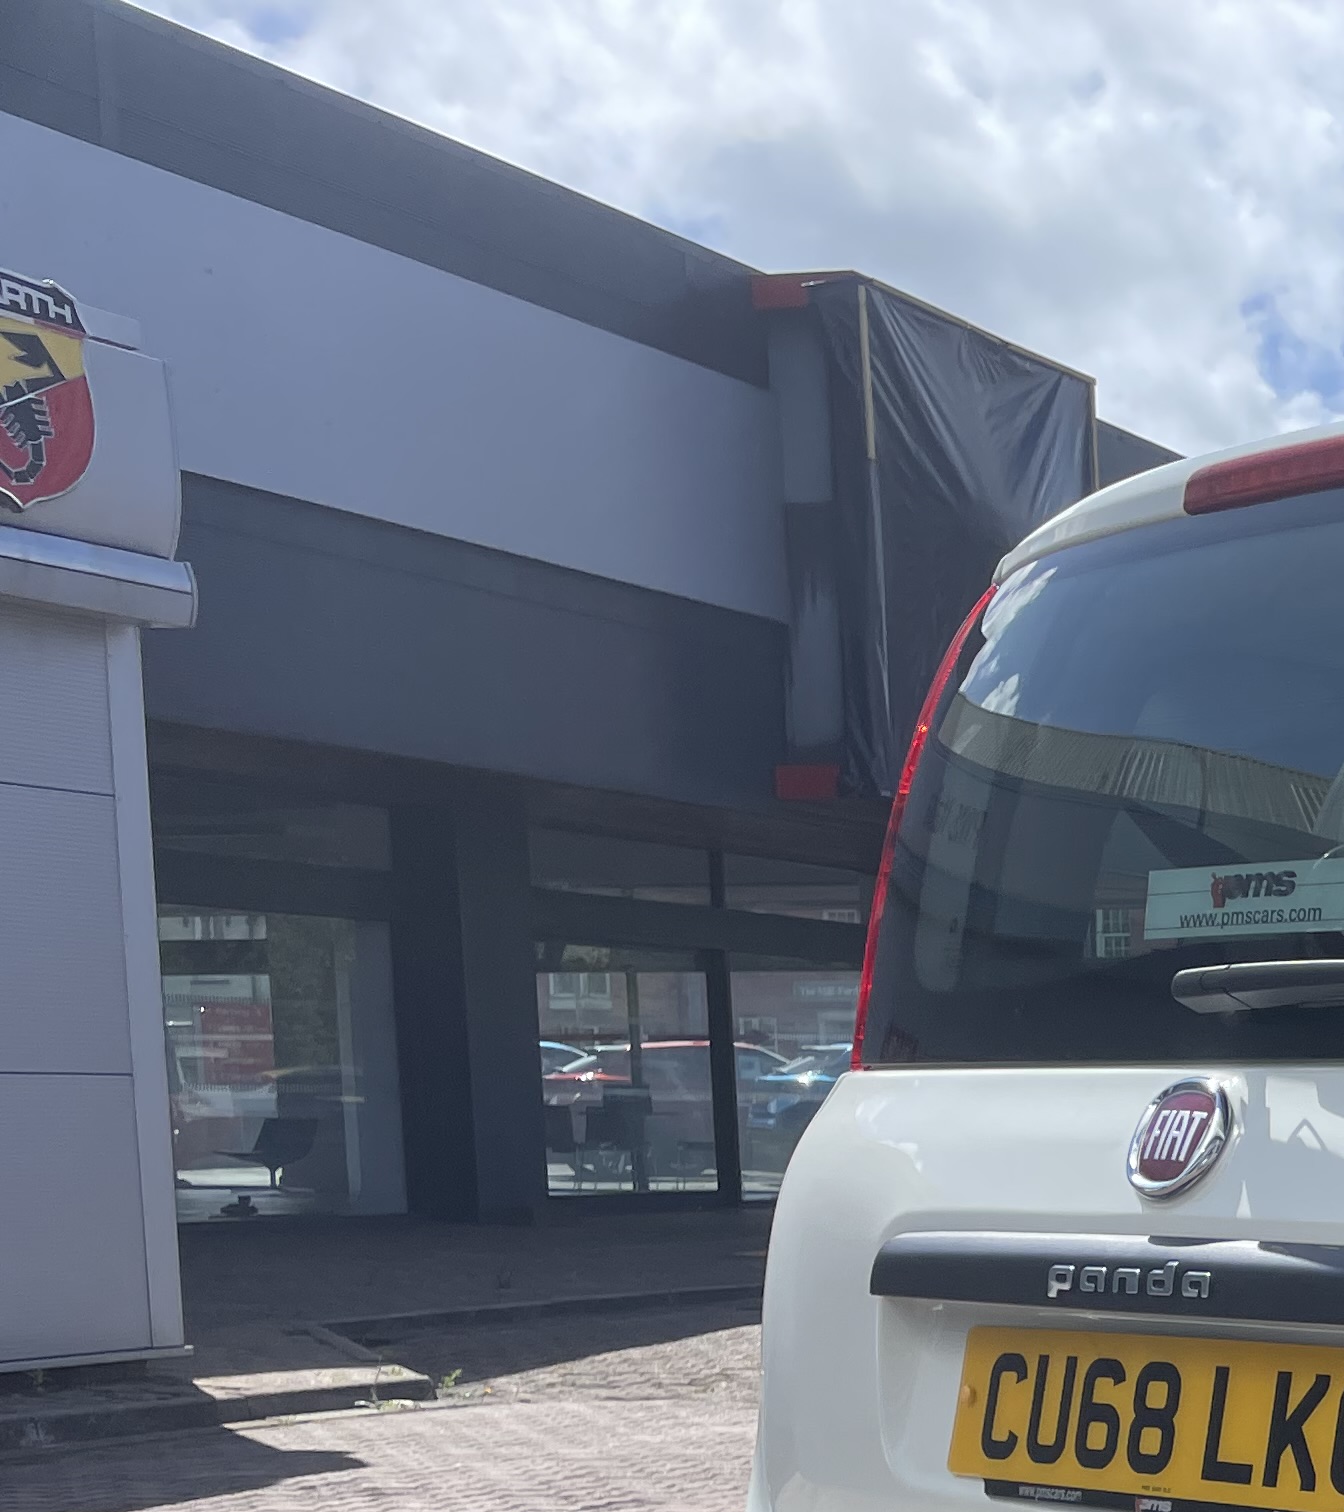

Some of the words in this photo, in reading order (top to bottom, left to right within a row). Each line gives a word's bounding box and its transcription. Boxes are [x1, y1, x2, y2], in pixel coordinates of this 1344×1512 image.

[0, 278, 73, 324] RTH
[1211, 870, 1297, 908] pms
[1180, 906, 1322, 928] www.pmscars.com
[1143, 1109, 1209, 1162] FIAT
[1046, 1260, 1211, 1298] panda
[980, 1352, 1182, 1475] CU68
